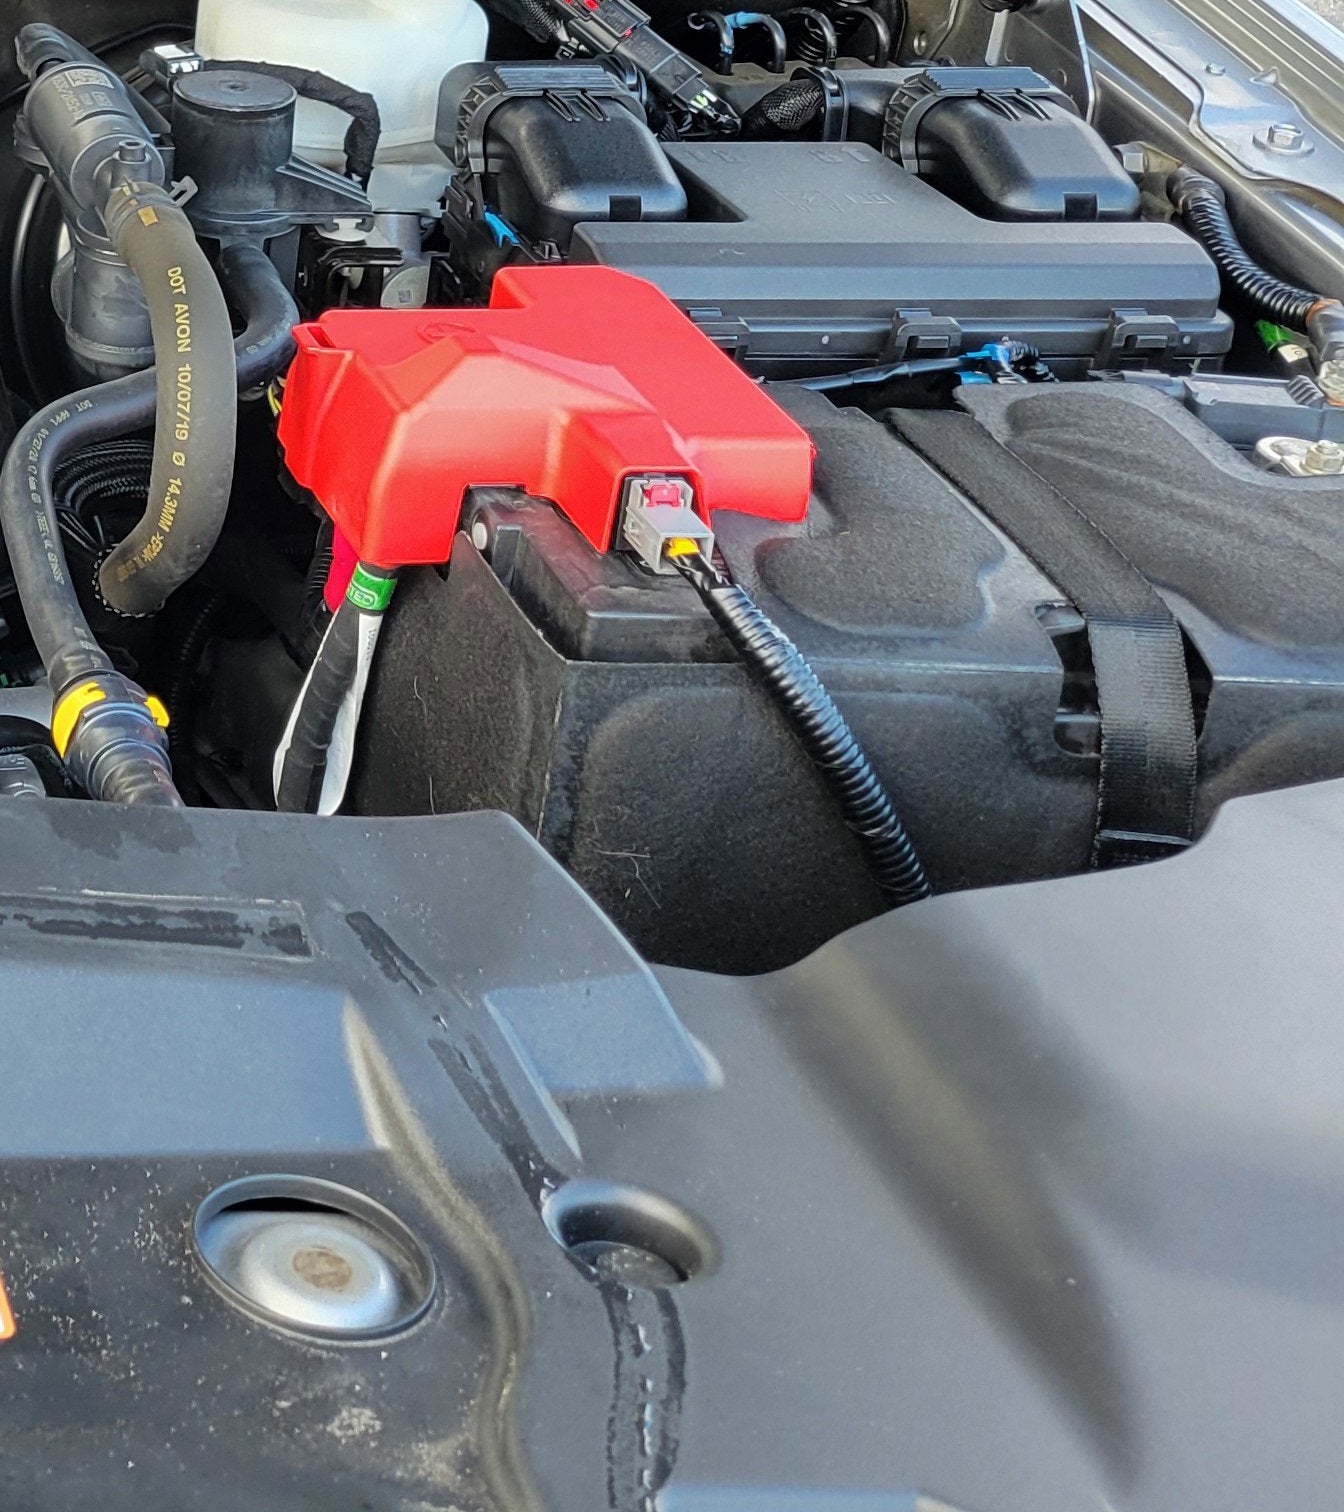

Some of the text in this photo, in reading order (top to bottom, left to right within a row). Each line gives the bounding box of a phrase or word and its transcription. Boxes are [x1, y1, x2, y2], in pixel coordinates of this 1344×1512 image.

[167, 266, 187, 295] DOT
[173, 303, 192, 353] AVON
[174, 363, 192, 442] 10/07/19
[157, 476, 183, 534] 14.3MM
